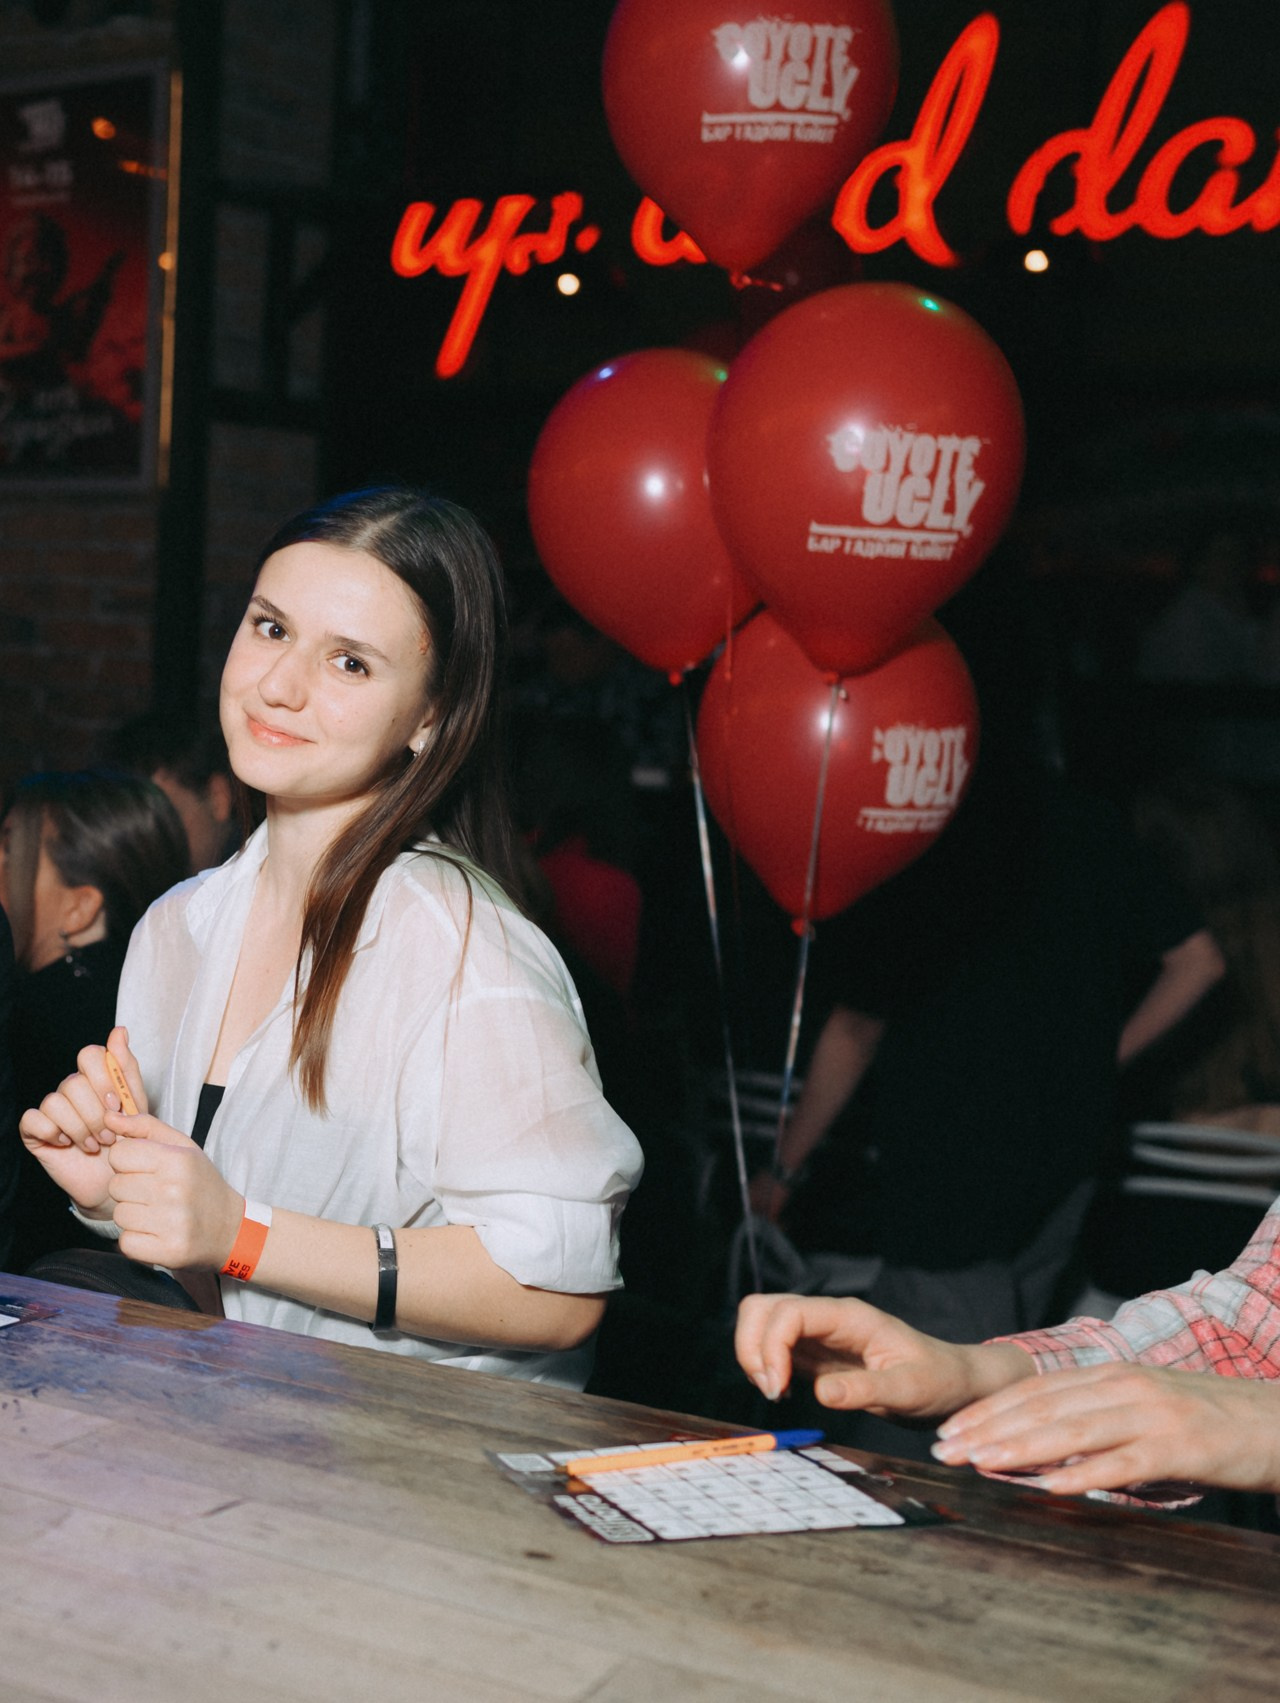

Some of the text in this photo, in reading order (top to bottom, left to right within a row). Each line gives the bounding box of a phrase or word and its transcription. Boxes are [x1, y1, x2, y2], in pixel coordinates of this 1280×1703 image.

[712, 17, 856, 63] COYOTE
[748, 58, 861, 120] UGLY
[826, 426, 983, 476] COYOTE
[862, 470, 986, 537] UGLY
[885, 760, 970, 808] UGLY
